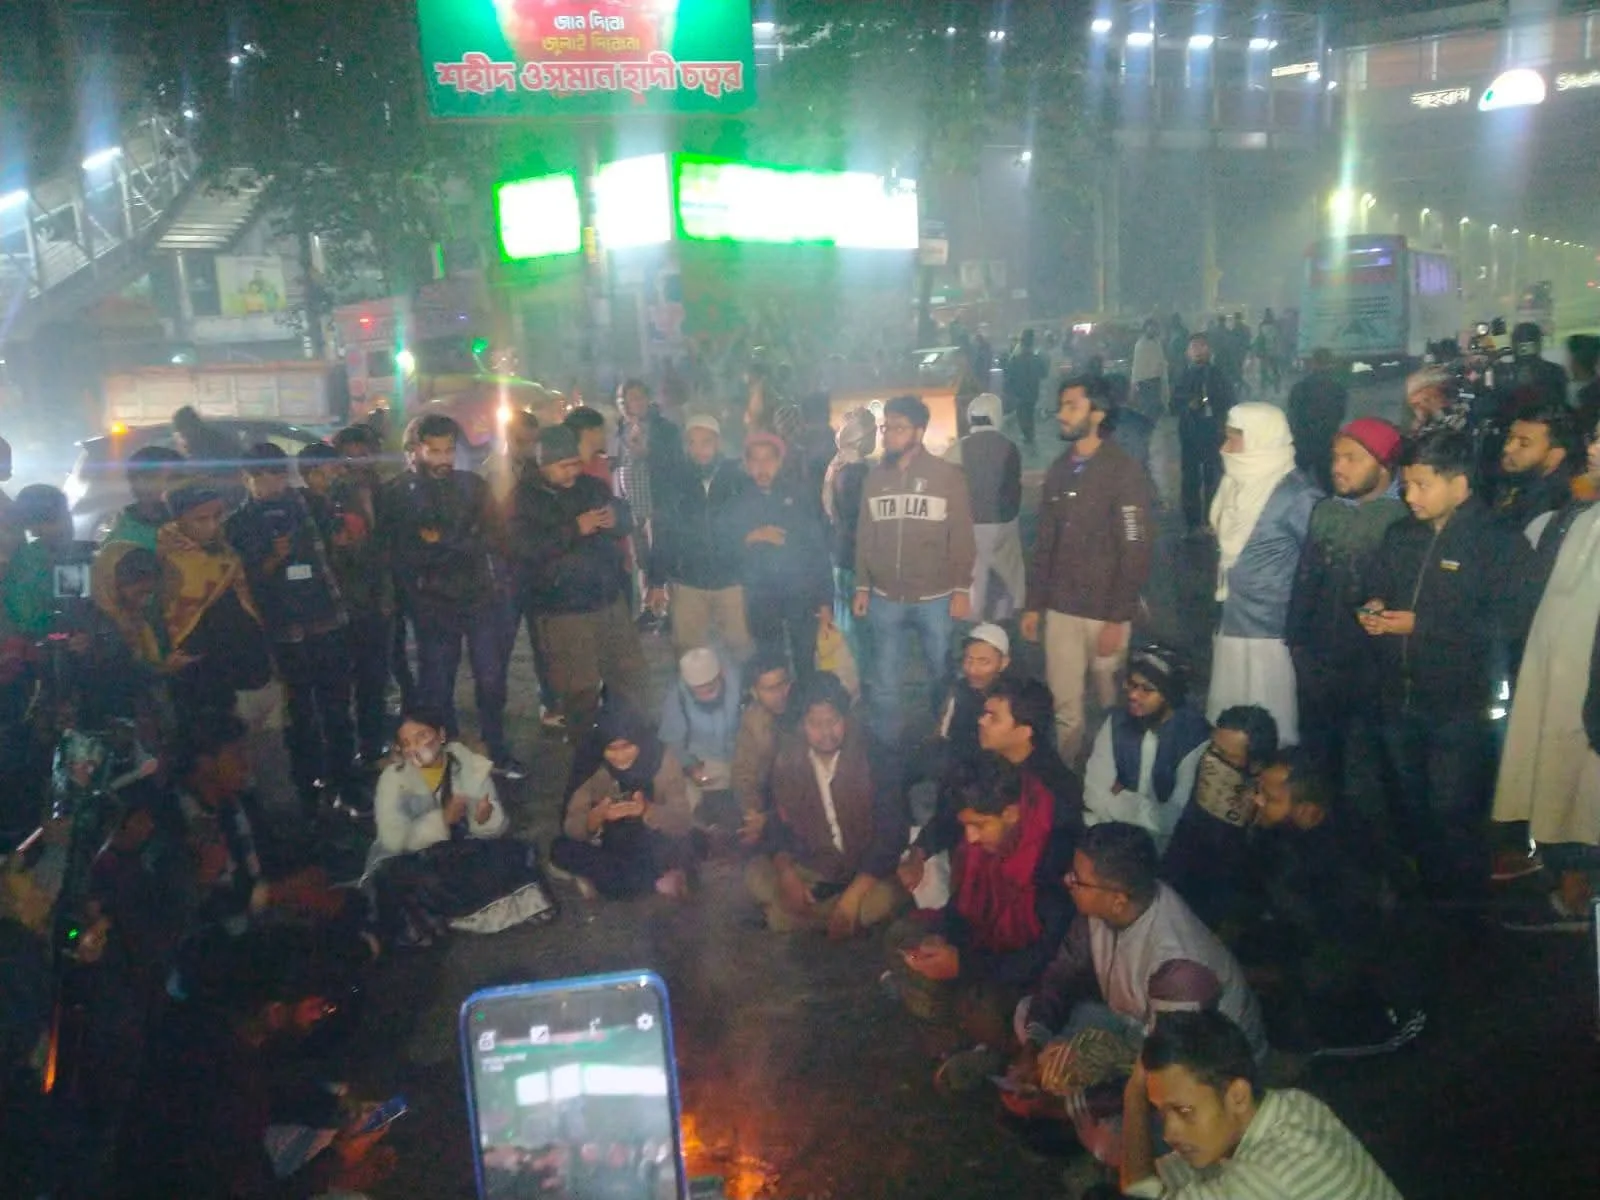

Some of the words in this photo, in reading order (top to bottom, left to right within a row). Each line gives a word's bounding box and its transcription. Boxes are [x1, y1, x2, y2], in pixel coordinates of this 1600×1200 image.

[554, 15, 585, 30] জান
[434, 51, 516, 94] শহীদ
[519, 61, 617, 91] ওসমান
[619, 50, 677, 94] হাদী
[678, 60, 743, 98] চত্বর
[877, 497, 929, 516] ITALIA
